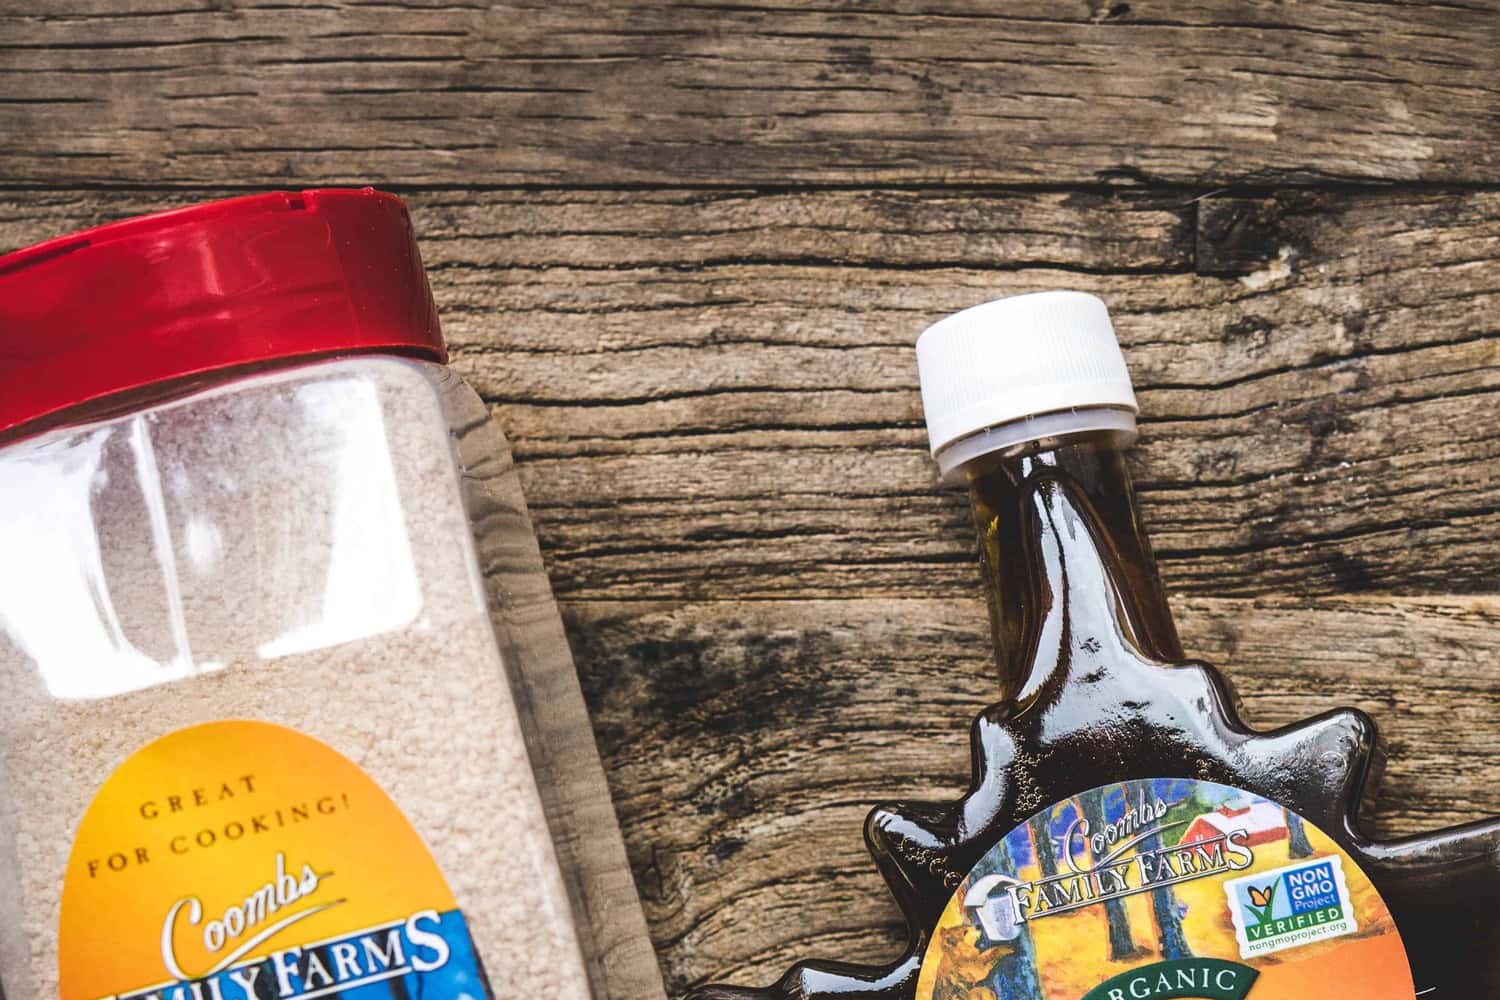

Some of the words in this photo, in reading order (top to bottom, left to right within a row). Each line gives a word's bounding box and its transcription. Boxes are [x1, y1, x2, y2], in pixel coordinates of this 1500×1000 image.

[139, 773, 255, 819] GREAT
[87, 847, 149, 879] FOR
[169, 792, 349, 854] COOKING!
[1065, 795, 1185, 873] Coombs
[1006, 864, 1130, 925] FAMILY
[1138, 829, 1254, 887] FARMS
[1288, 865, 1329, 887] NON
[1290, 879, 1334, 900] GMO
[161, 854, 347, 981] Coombs
[1250, 907, 1340, 938] VERIFIED
[1294, 893, 1336, 912] Project
[273, 910, 451, 998] FARMS
[1248, 920, 1347, 952] nongmoproject.org
